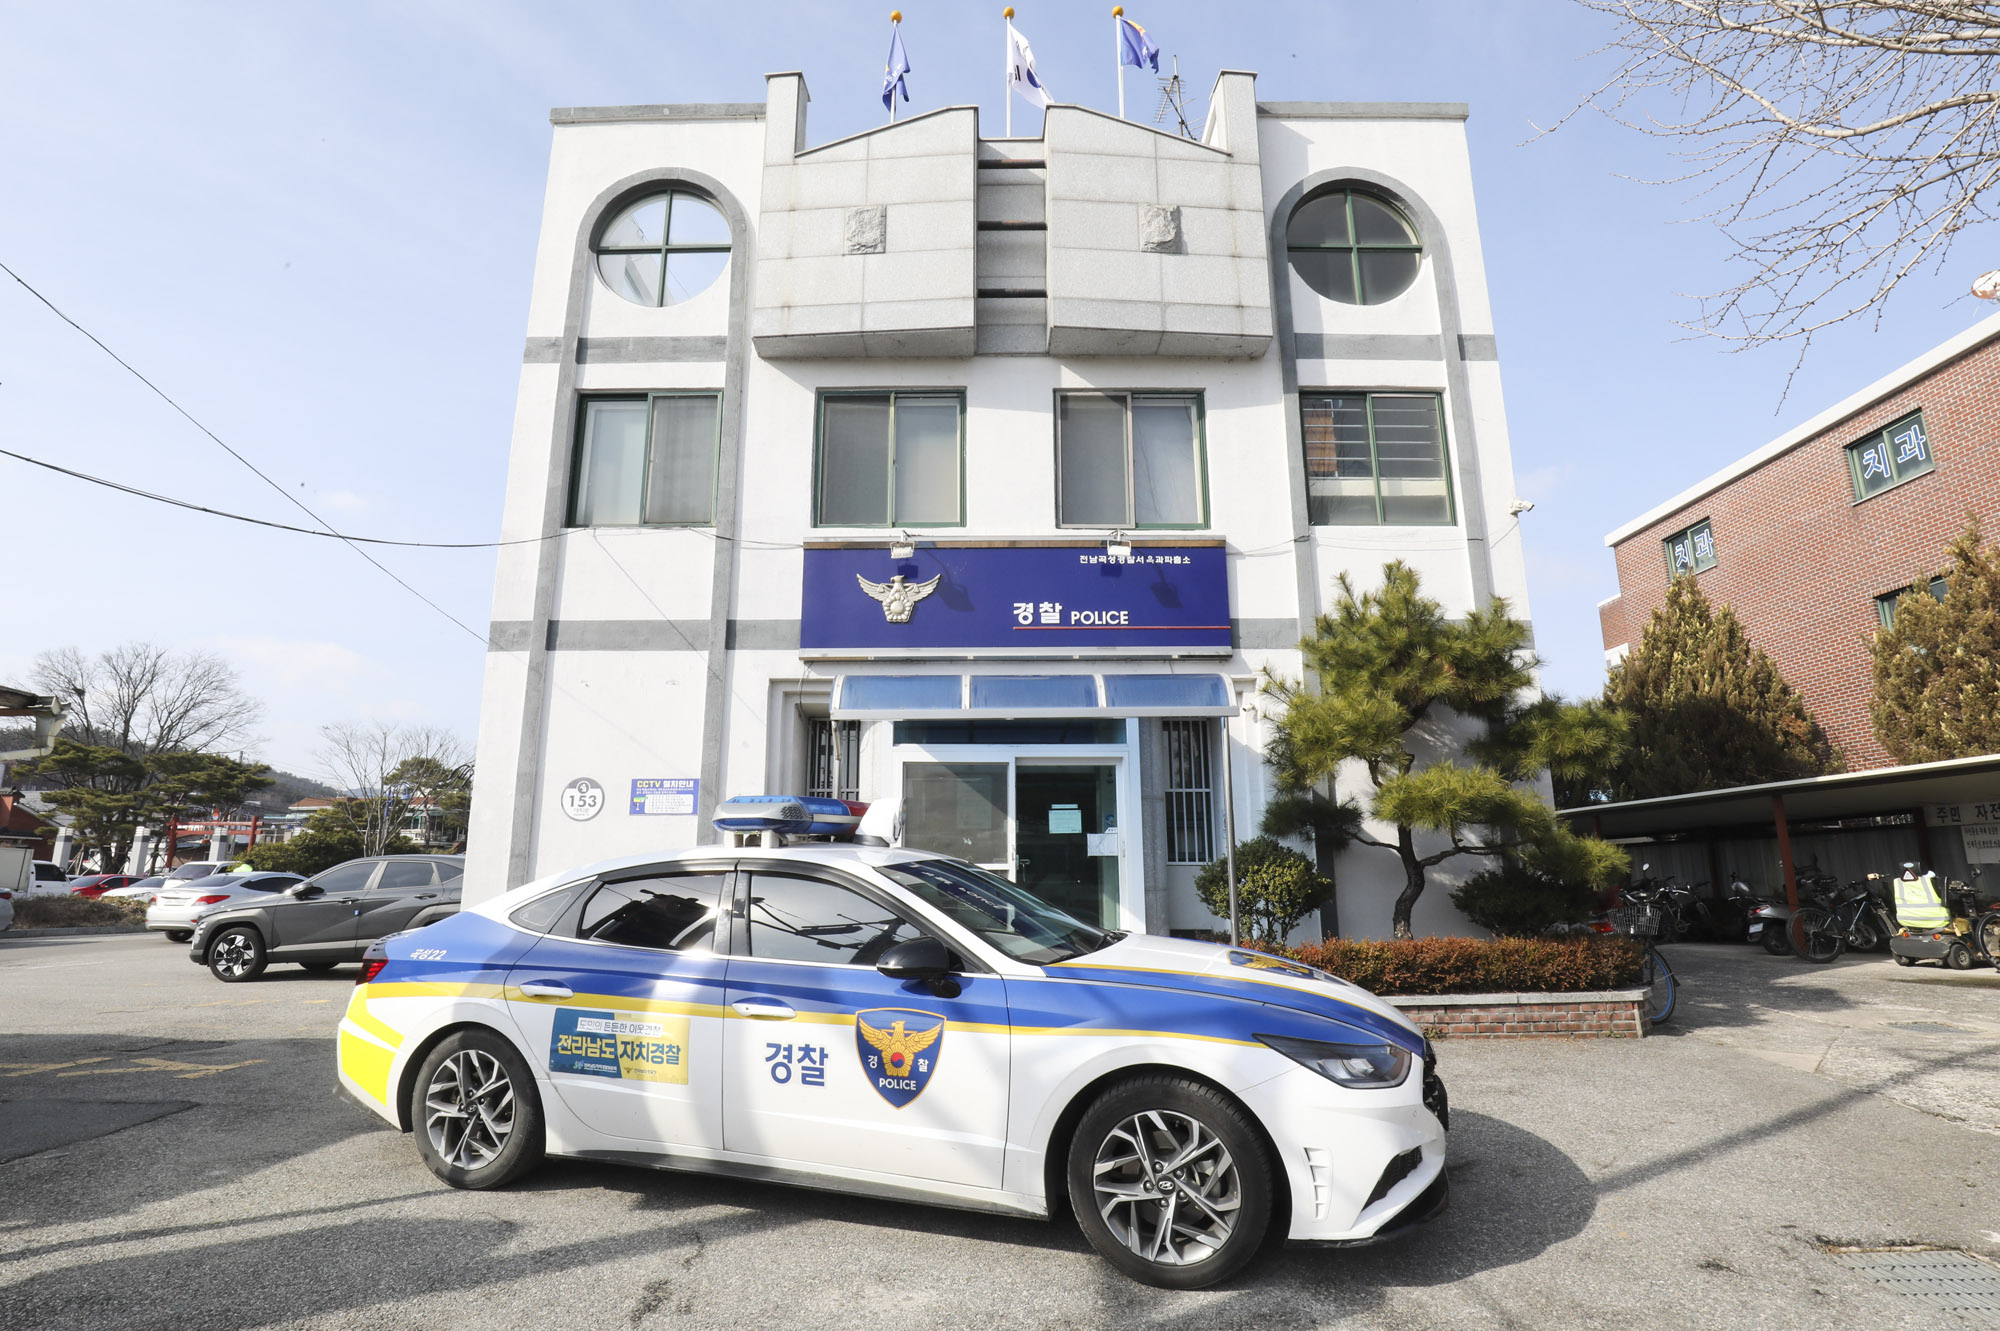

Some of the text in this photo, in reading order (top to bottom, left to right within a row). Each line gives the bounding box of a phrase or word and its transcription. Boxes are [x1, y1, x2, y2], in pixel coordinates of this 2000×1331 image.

[1863, 424, 1926, 479] 치과
[1675, 529, 1714, 568] 치과
[1013, 601, 1129, 625] 경찰 POLICE
[637, 780, 661, 788] CCTV
[569, 794, 597, 808] 153
[1937, 806, 1961, 823] 주민
[603, 1022, 628, 1034] 든든한
[557, 1034, 681, 1066] 전라남도 자치경찰
[765, 1042, 829, 1087] 경찰
[867, 1055, 929, 1073] 경 찰
[879, 1077, 917, 1091] POLICE
